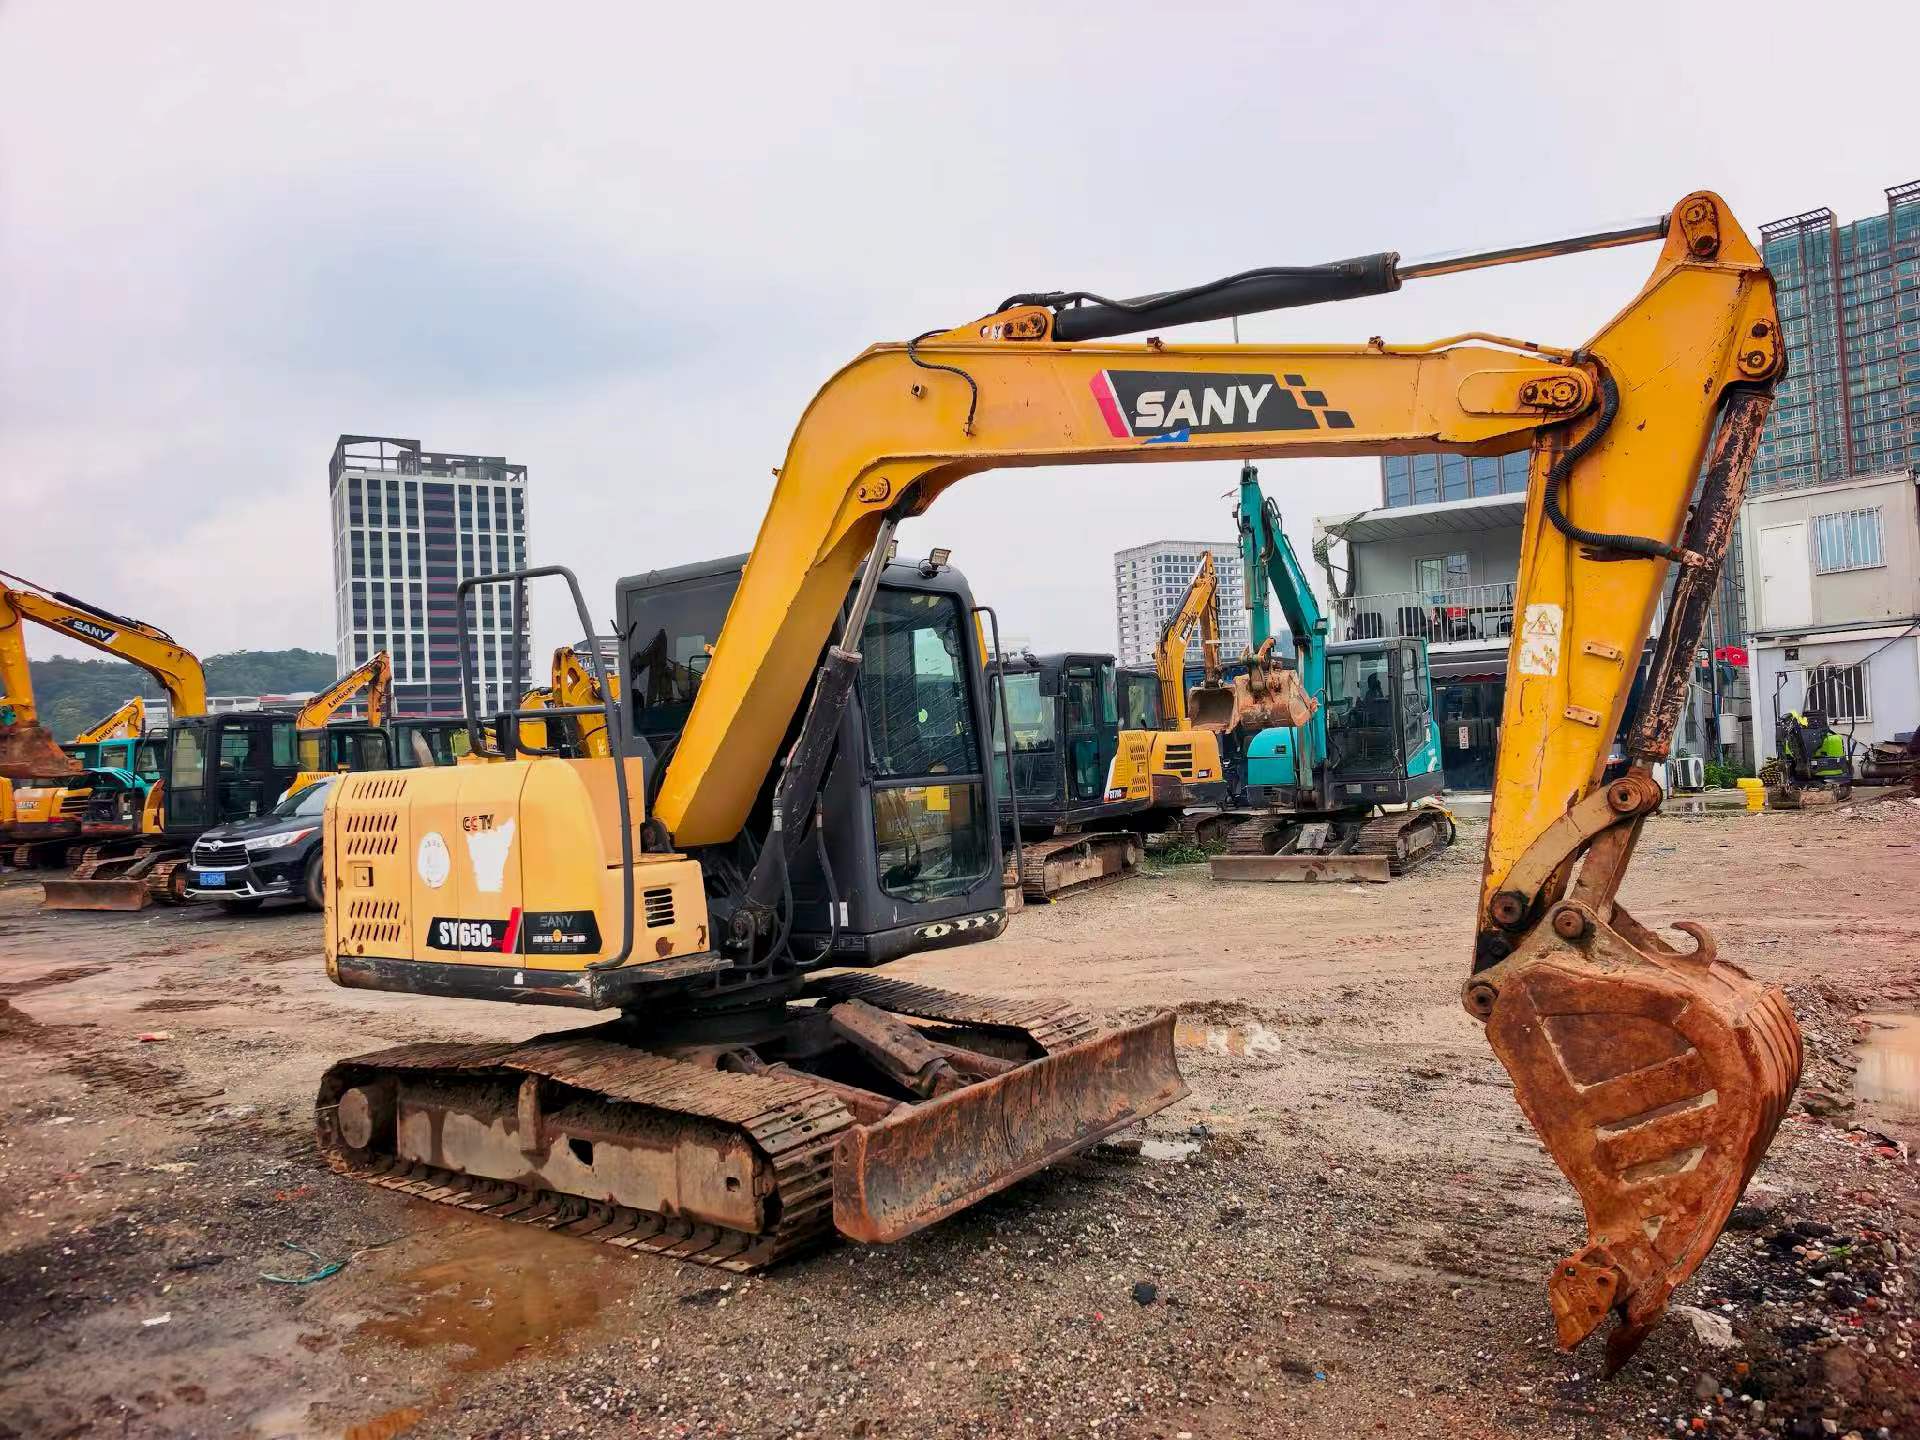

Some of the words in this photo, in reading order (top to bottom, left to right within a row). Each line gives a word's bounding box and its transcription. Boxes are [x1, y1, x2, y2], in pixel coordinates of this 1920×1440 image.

[1135, 383, 1273, 428] SANY
[73, 621, 110, 639] SANY
[462, 814, 495, 832] CCTV
[540, 914, 574, 928] SANY
[439, 921, 493, 948] SY65C
